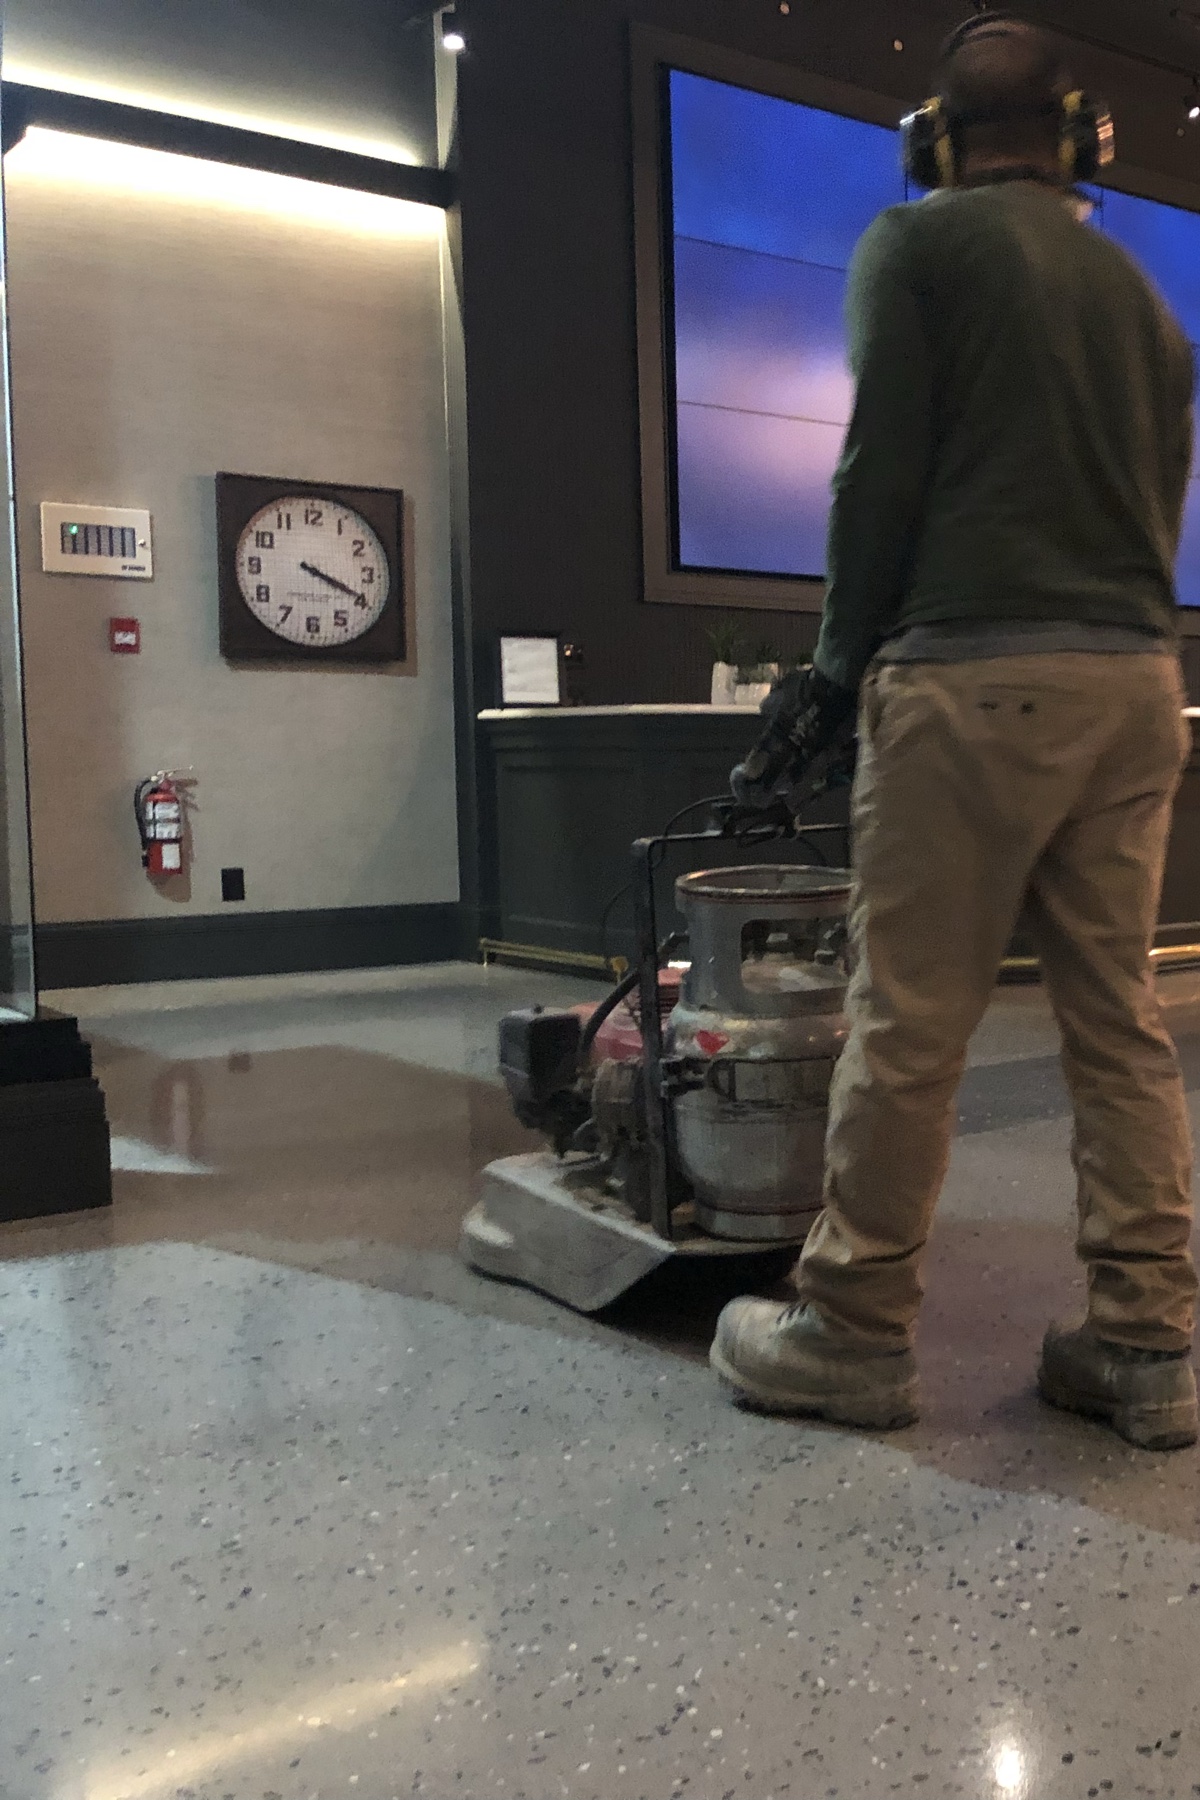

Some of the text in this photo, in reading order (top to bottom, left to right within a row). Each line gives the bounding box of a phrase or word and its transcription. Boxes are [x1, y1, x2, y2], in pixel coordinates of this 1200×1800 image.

[277, 511, 291, 530] 11
[304, 509, 323, 526] 12
[337, 518, 343, 535] 1
[255, 530, 274, 549] 10
[352, 539, 365, 556] 2
[248, 556, 262, 574] 9
[361, 566, 375, 584] 3
[256, 584, 270, 602] 8
[279, 604, 293, 624] 7
[334, 610, 348, 627] 5
[305, 615, 320, 633] 6
